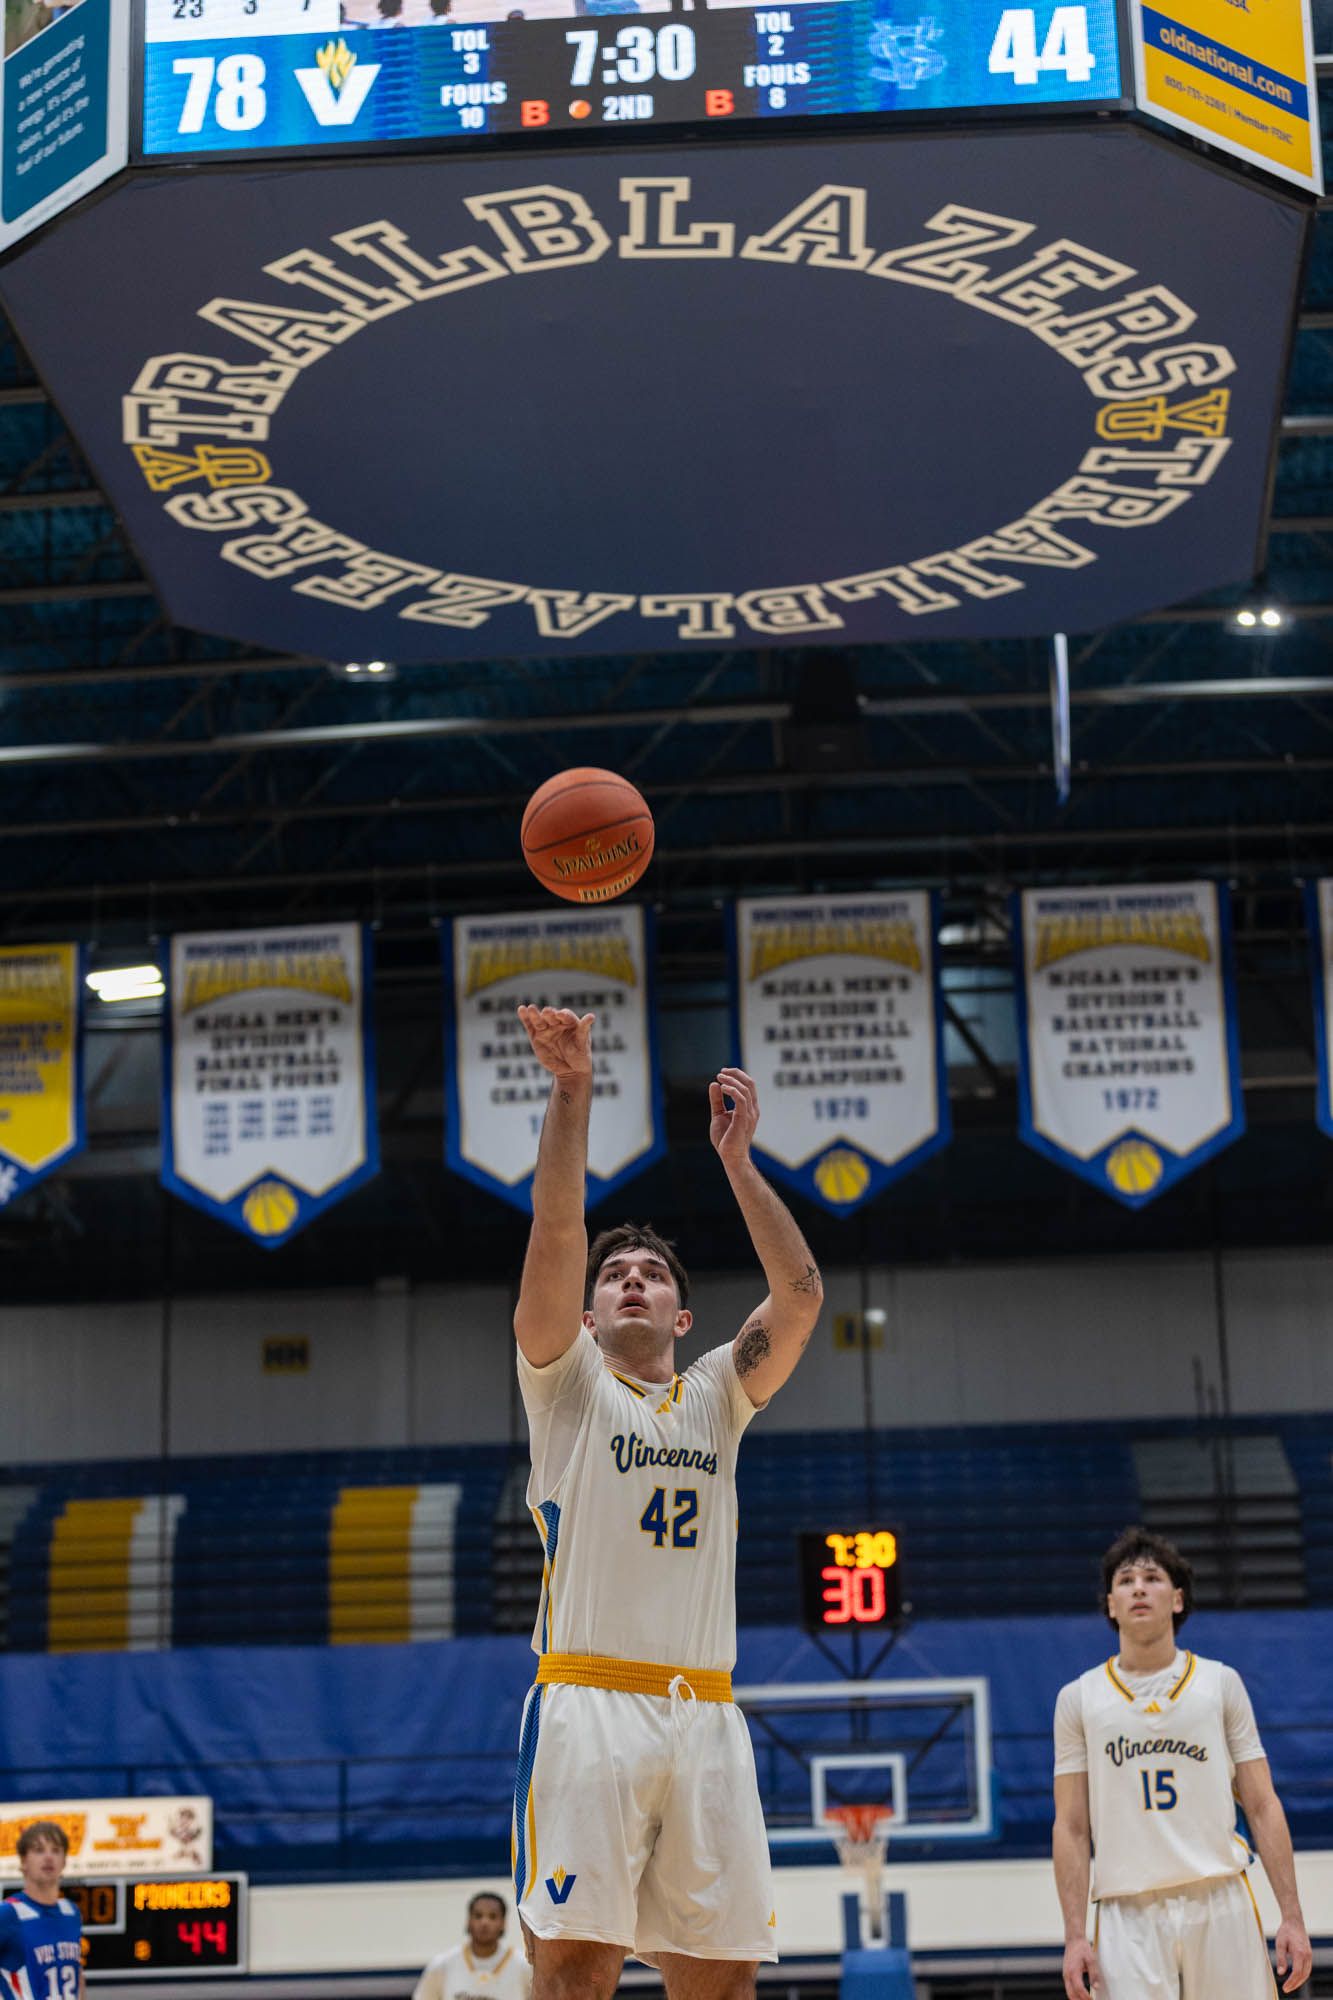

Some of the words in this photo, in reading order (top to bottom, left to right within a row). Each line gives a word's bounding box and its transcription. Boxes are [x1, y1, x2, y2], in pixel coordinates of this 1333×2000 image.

[755, 11, 794, 34] TOL
[451, 29, 490, 52] TOL
[768, 34, 785, 56] 2
[989, 6, 1095, 85] 44
[463, 52, 480, 74] 3
[565, 23, 696, 86] 7:30
[1160, 27, 1292, 104] oldnational.com
[744, 62, 812, 87] FOULS
[173, 54, 266, 133] 78
[440, 81, 508, 106] FOULS
[705, 89, 734, 116] B
[458, 106, 484, 129] 10
[521, 99, 550, 127] B
[602, 94, 655, 121] 2ND
[122, 177, 1237, 446] TRAILBLAZERS
[164, 438, 1232, 640] TRAILBLAZERS
[552, 832, 640, 880] SPALDING
[843, 975, 910, 994] MEN'S
[1131, 966, 1199, 984] MEN'S
[780, 1000, 877, 1020] DIVISION
[1067, 991, 1165, 1010] DIVISION
[764, 1021, 910, 1044] BASKETBALL
[1052, 1011, 1199, 1035] BASKETBALL
[780, 1042, 895, 1064] NATIONAL
[1069, 1035, 1187, 1055] NATIONAL
[195, 1049, 339, 1072] BASKETBALL
[1062, 1056, 1194, 1079] CHAMPIONS
[195, 1073, 262, 1094] FINAL
[773, 1066, 905, 1089] CHAMPIONS
[610, 1432, 718, 1476] Vincennes
[639, 1485, 698, 1550] 42
[826, 1531, 896, 1568] 7:30
[821, 1566, 886, 1623] 30
[1105, 1735, 1208, 1767] Vincennes
[1140, 1769, 1179, 1813] 15
[177, 1919, 227, 1955] 44
[44, 1965, 77, 2000] 12
